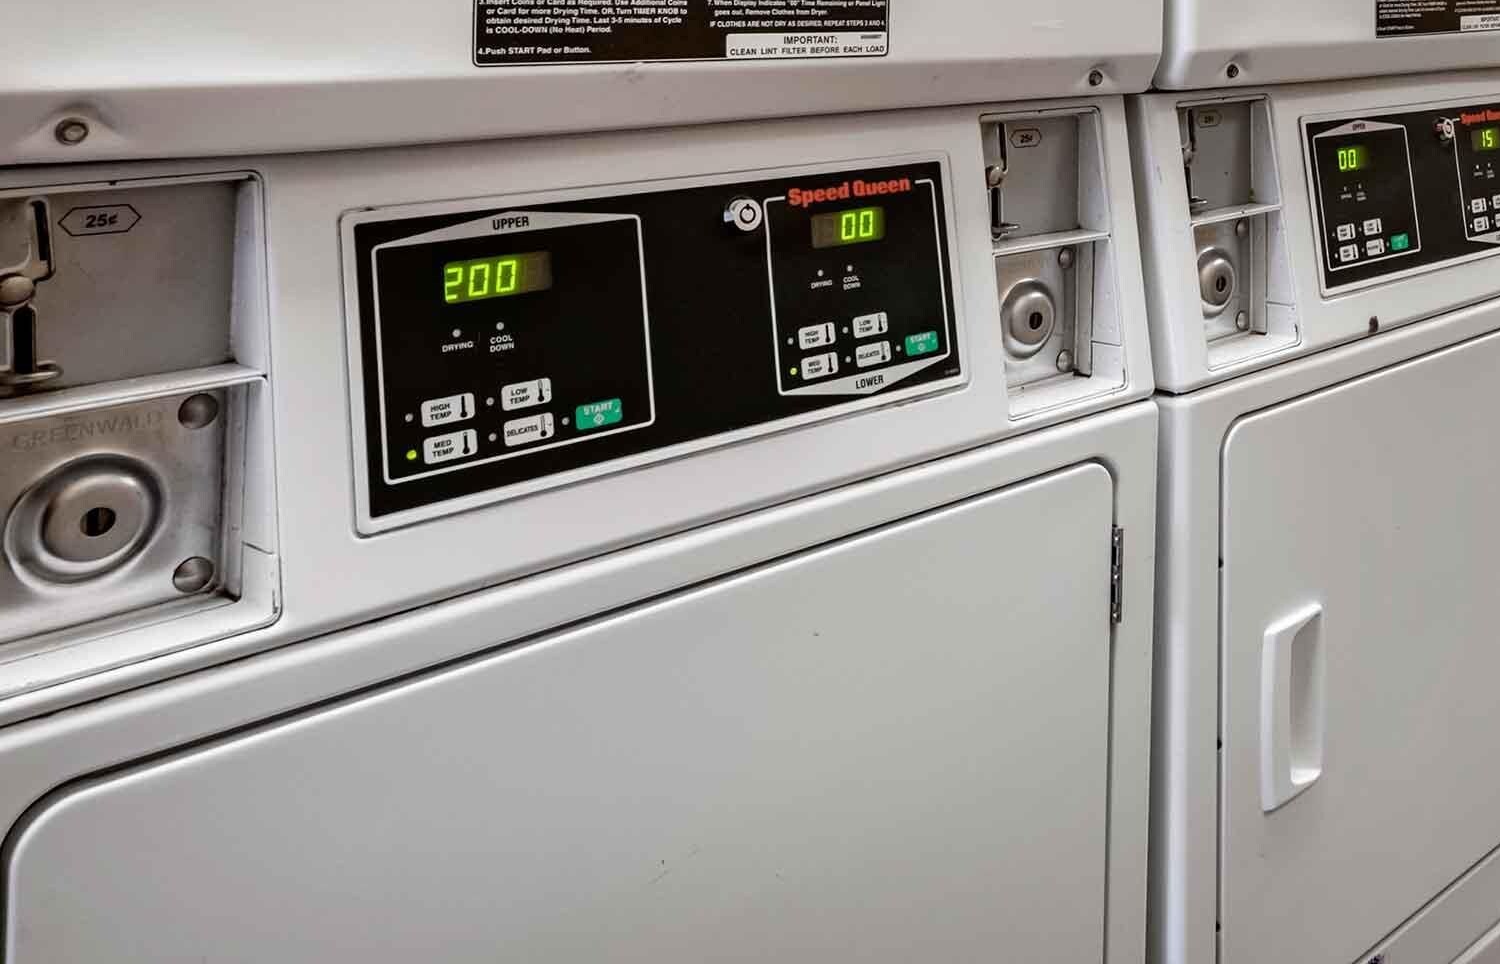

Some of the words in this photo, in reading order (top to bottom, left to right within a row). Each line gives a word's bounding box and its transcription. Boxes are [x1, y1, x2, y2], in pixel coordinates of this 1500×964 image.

[496, 7, 517, 15] Card
[553, 7, 579, 16] Drying
[616, 7, 632, 15] Turn
[633, 7, 656, 15] TIMER
[657, 7, 679, 15] KNOB
[544, 16, 570, 25] Drying
[662, 16, 682, 25] Cycle
[486, 26, 493, 34] is
[495, 26, 548, 34] COOL-DOWN
[549, 26, 563, 34] (No
[564, 26, 585, 34] Heat)
[783, 35, 838, 44] IMPORTANT:
[508, 46, 535, 54] START
[536, 46, 552, 54] Pad
[729, 47, 757, 56] CLEAN
[760, 47, 778, 55] LINT
[781, 46, 807, 55] FILTER
[810, 45, 840, 54] BEFORE
[843, 45, 863, 53] EACH
[866, 44, 886, 53] LOAD
[1338, 149, 1357, 171] 00
[788, 181, 850, 208] Speed
[852, 177, 911, 197] Queen
[85, 213, 118, 229] 25¢
[492, 215, 530, 231] UPPER
[841, 210, 873, 241] 00
[444, 259, 517, 302] 200
[489, 334, 513, 345] COOL
[441, 340, 474, 353] DRYING
[489, 342, 515, 353] DOWN
[855, 373, 884, 389] LOWER
[510, 387, 528, 397] LOW
[509, 394, 531, 406] TEMP
[430, 401, 451, 414] HIGH
[583, 401, 614, 415] START
[429, 410, 453, 423] TEMP
[506, 424, 539, 438] DELICATES
[433, 438, 452, 450] MED
[432, 446, 456, 459] TEMP
